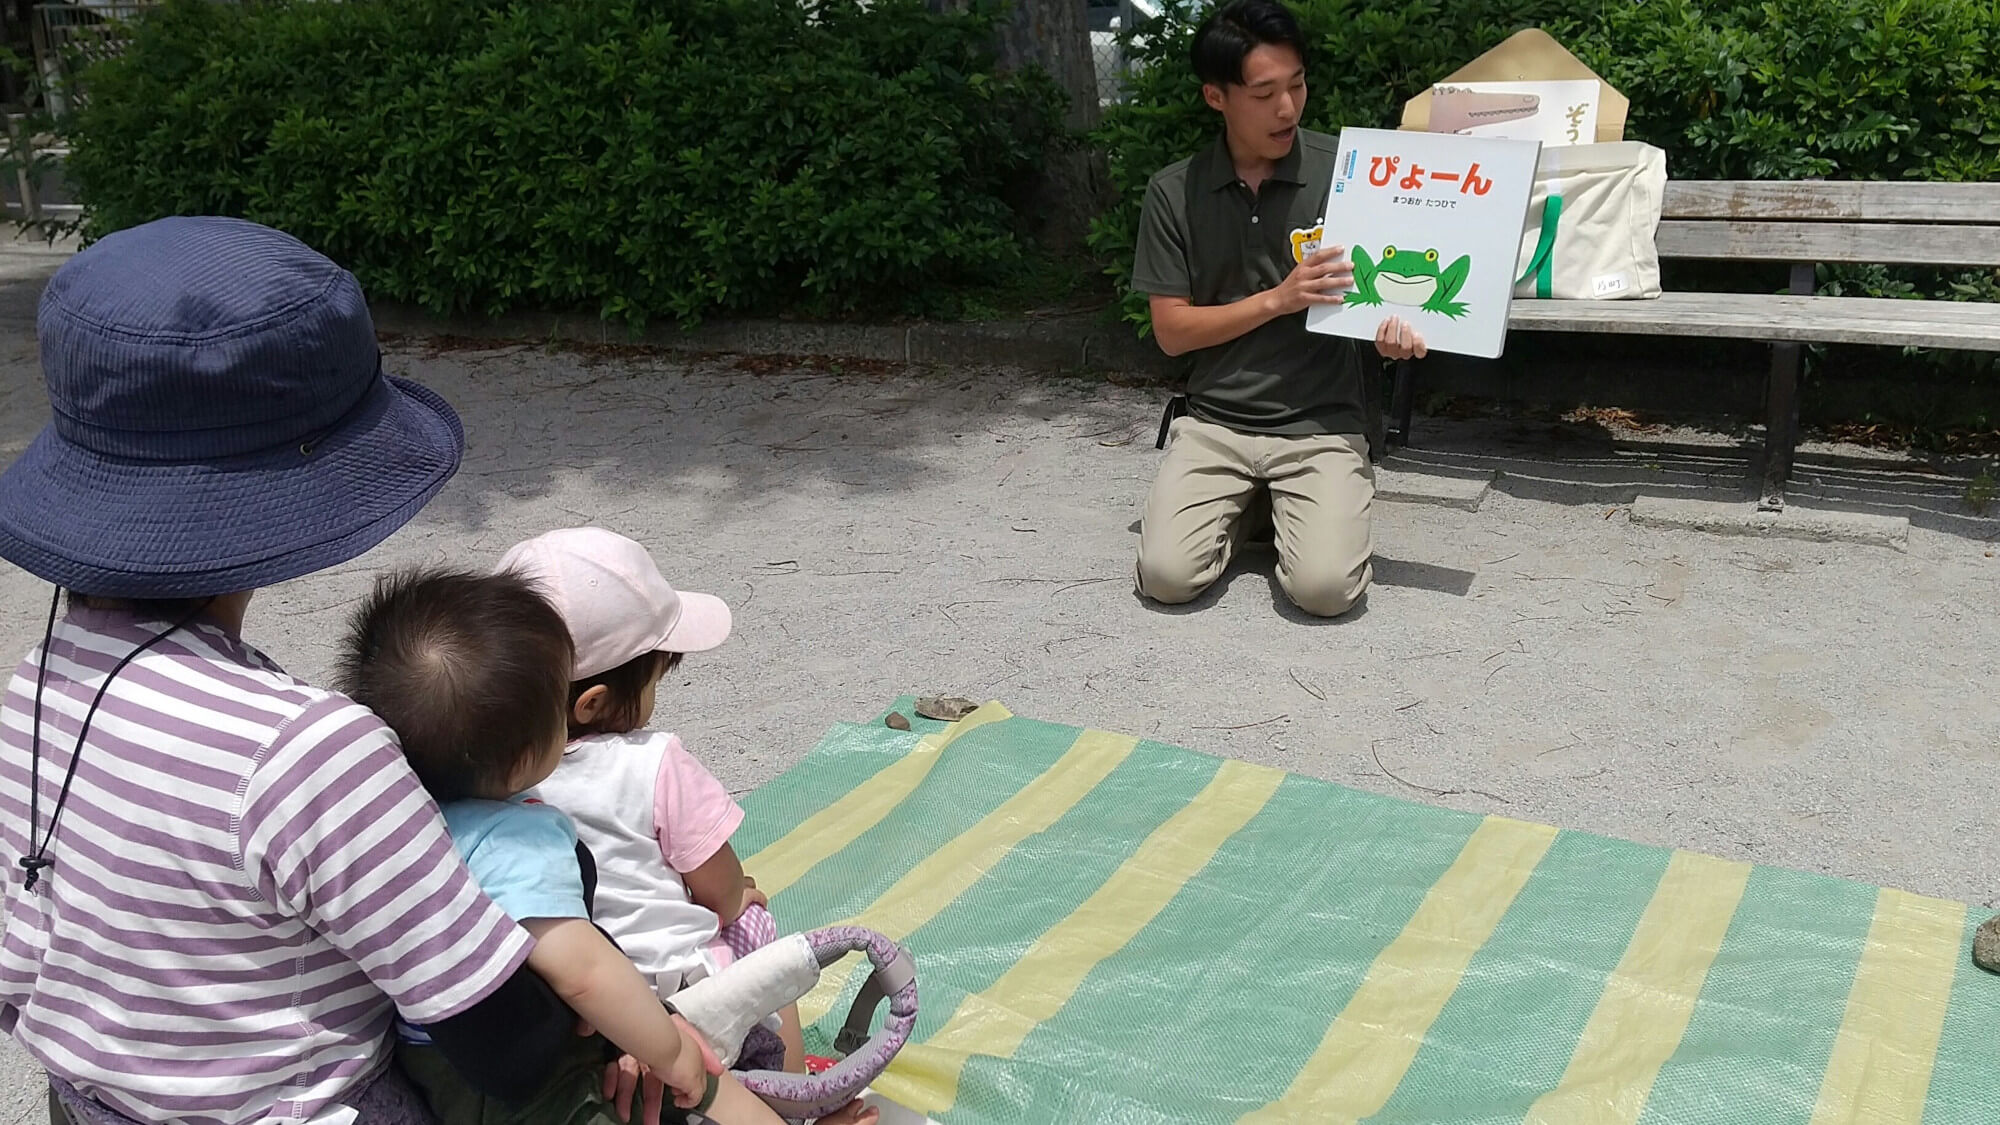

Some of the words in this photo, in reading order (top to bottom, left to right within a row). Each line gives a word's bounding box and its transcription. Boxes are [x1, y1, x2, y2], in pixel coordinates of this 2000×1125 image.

[1565, 103, 1589, 145] ぞう
[1368, 155, 1493, 196] ぴょーん
[1392, 196, 1423, 206] まつおか
[1426, 199, 1457, 209] たつひで
